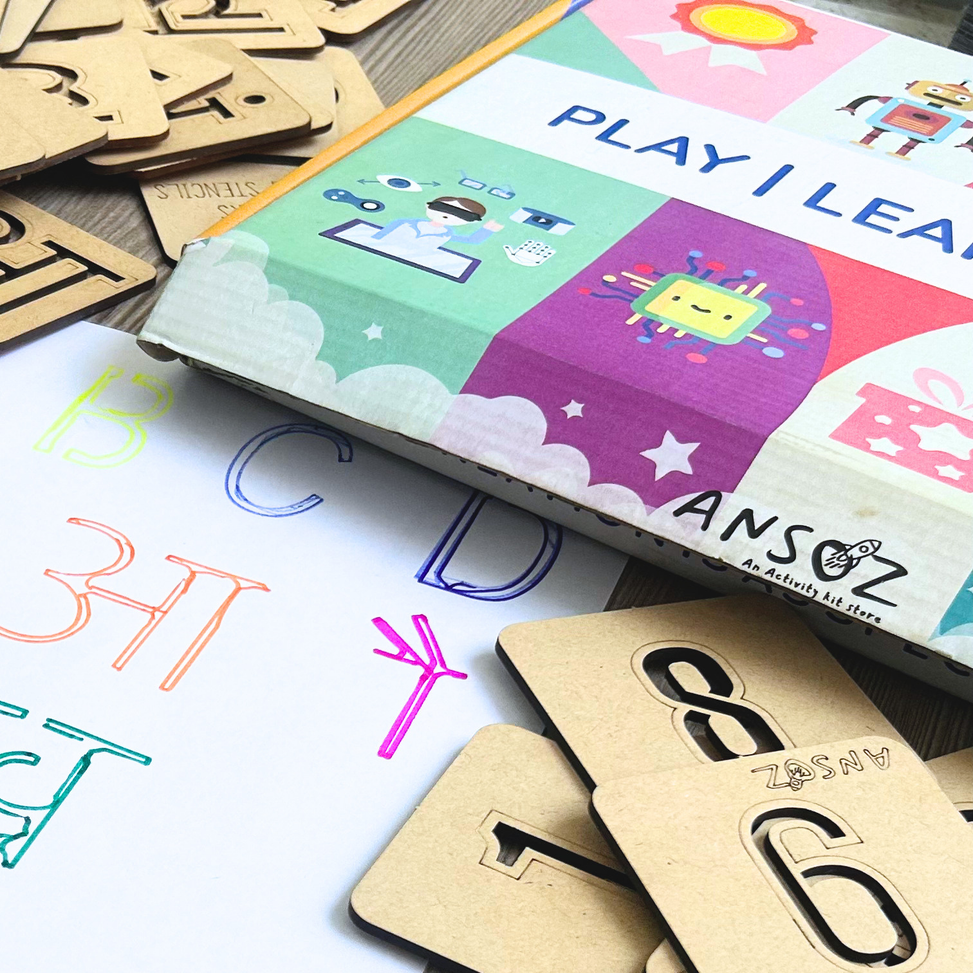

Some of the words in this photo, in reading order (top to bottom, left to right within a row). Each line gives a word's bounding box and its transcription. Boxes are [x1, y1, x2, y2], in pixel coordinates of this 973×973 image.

[547, 104, 751, 174] PLAY
[803, 181, 973, 261] LEA
[33, 364, 175, 469] B
[225, 422, 355, 518] C
[415, 488, 563, 602] D
[672, 490, 908, 608] ANSOZ
[741, 557, 760, 572] An
[764, 567, 820, 599] Activity
[823, 590, 843, 608] kit
[845, 602, 882, 625] store
